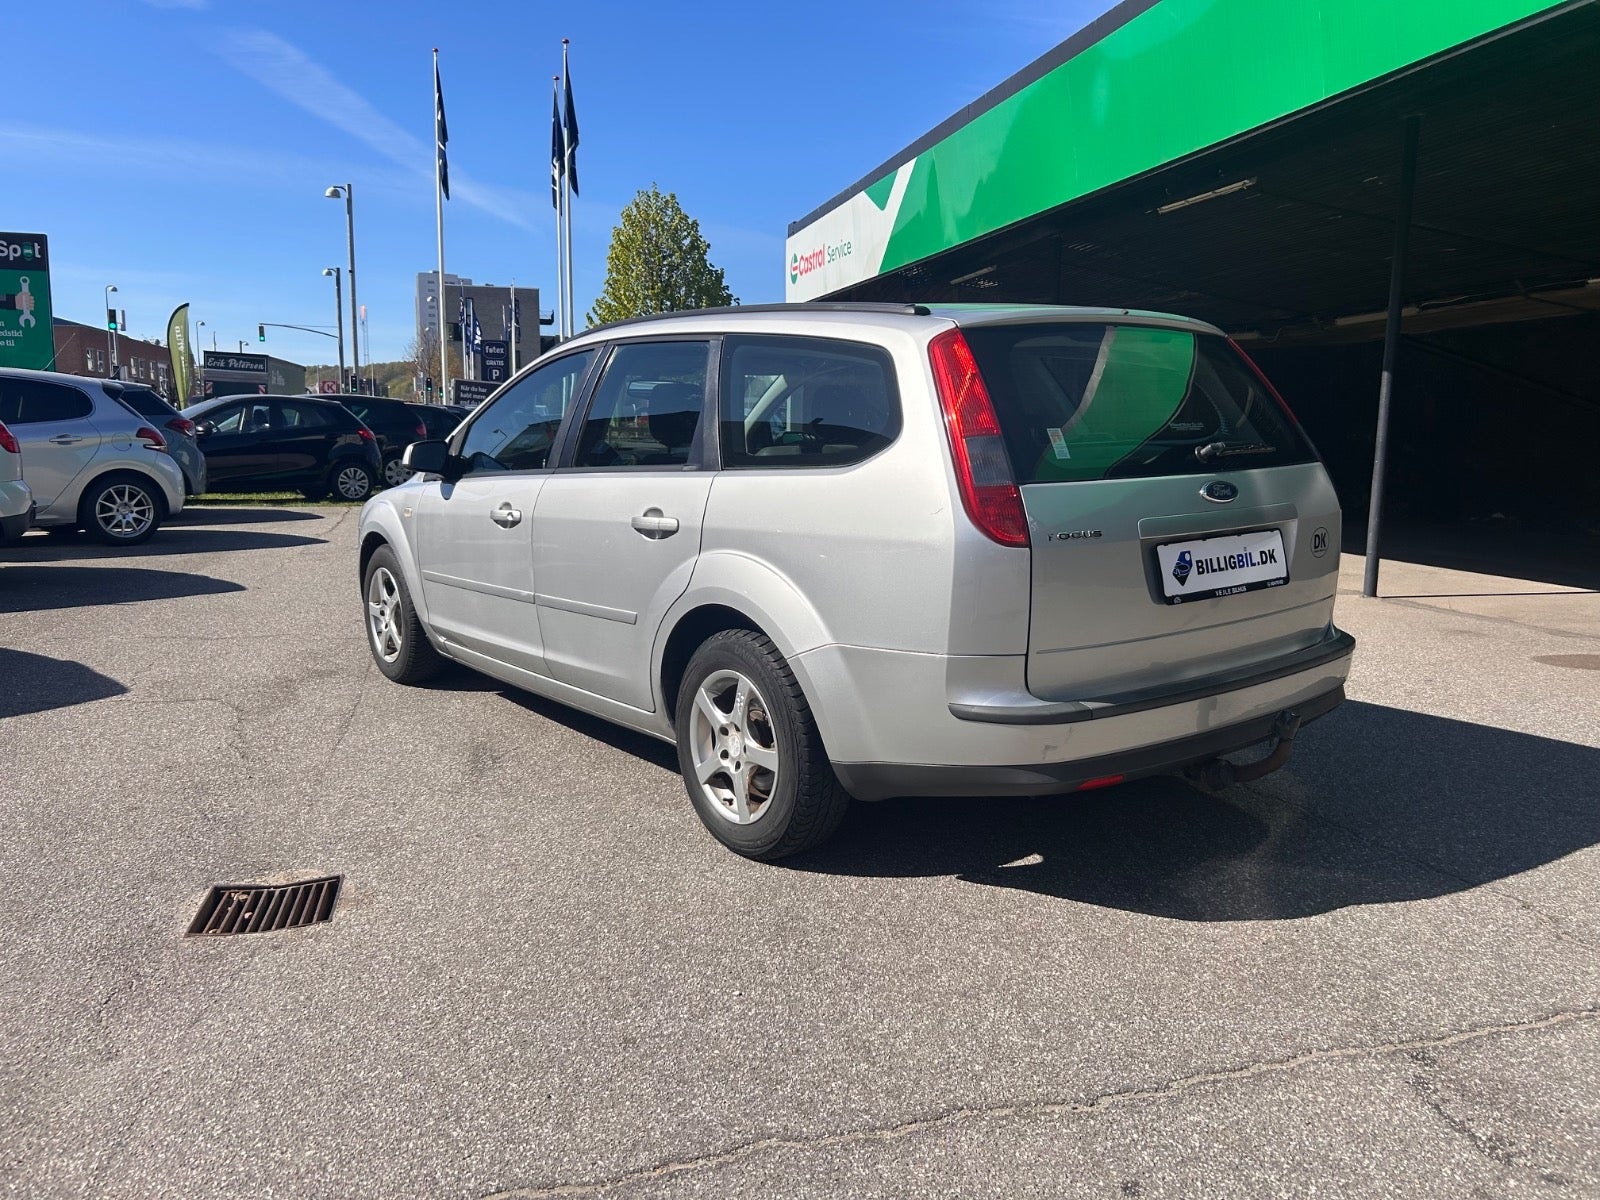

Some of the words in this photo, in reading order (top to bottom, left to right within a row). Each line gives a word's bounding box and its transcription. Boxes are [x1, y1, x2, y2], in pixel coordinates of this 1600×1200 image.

[799, 244, 825, 276] Castrol
[827, 239, 852, 263] Service
[207, 357, 226, 368] Erik
[228, 358, 265, 370] Petersen
[492, 369, 500, 380] P
[1048, 530, 1103, 541] FOCUS
[1313, 532, 1327, 550] DK
[1195, 549, 1277, 575] BILLIGBIL.DK
